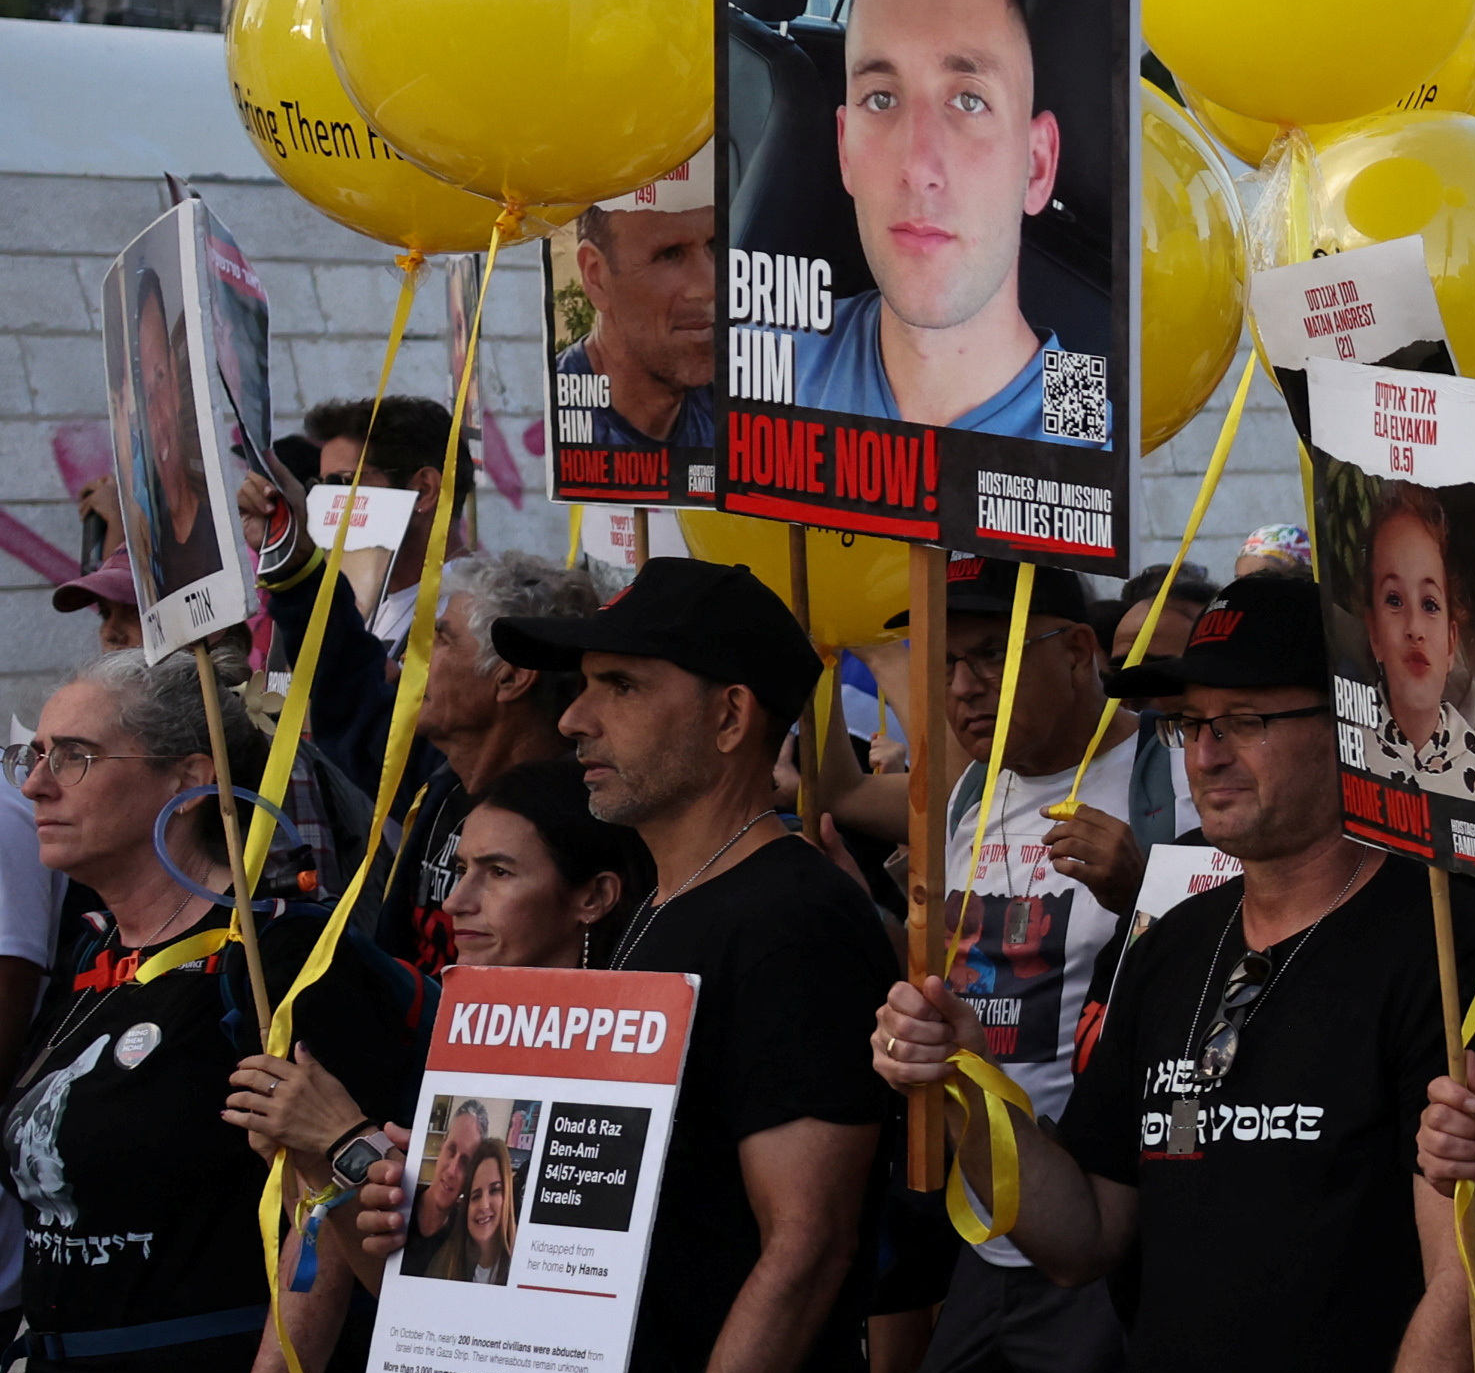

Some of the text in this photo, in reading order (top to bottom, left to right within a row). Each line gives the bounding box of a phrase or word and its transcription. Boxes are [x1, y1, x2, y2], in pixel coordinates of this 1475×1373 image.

[728, 248, 833, 332] BRING
[1304, 303, 1376, 339] MATAN ANGREST
[1335, 333, 1356, 361] (21)
[728, 327, 795, 406] HIM
[1374, 381, 1437, 415] אלה אליקים
[1374, 411, 1437, 447] ELA ELYAKIM
[728, 412, 939, 513] HOME NOW!
[1390, 444, 1414, 476] (8.5)
[978, 471, 1112, 512] HOSTAGES AND MISSING
[977, 496, 1113, 548] FAMILIES FORUM
[448, 1002, 667, 1054] KIDNAPPED
[554, 1117, 622, 1137] Ohad & Raz
[550, 1140, 600, 1159] Ben-Ami
[545, 1165, 626, 1186] 54|57-year-old
[540, 1187, 581, 1206] Israelis
[527, 1259, 608, 1277] her home by Hamas
